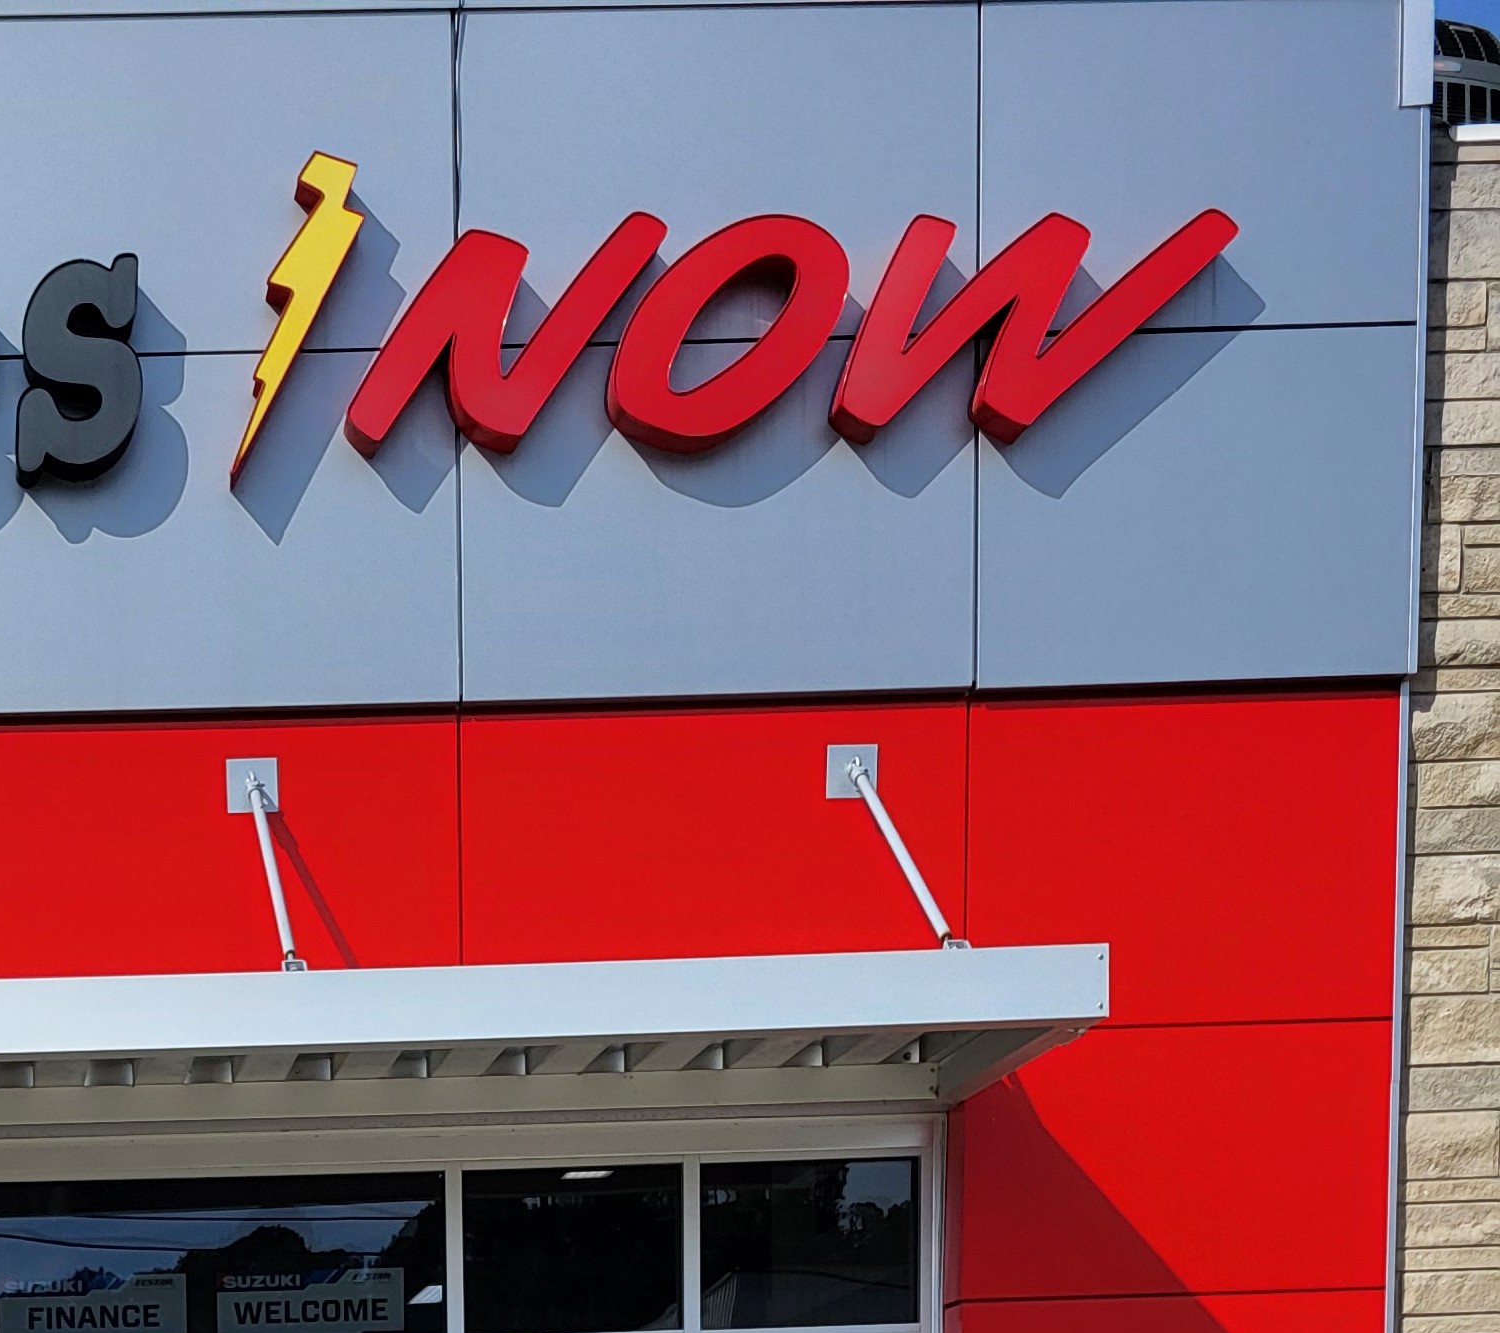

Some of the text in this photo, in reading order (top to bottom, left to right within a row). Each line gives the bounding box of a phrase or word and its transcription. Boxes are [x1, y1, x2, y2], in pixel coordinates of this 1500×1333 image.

[344, 208, 1240, 457] NOW
[3, 1279, 83, 1294] SUZUKI
[223, 1274, 301, 1289] SUZUKI
[27, 1304, 161, 1330] FINANCE
[233, 1298, 389, 1325] WELCOME
